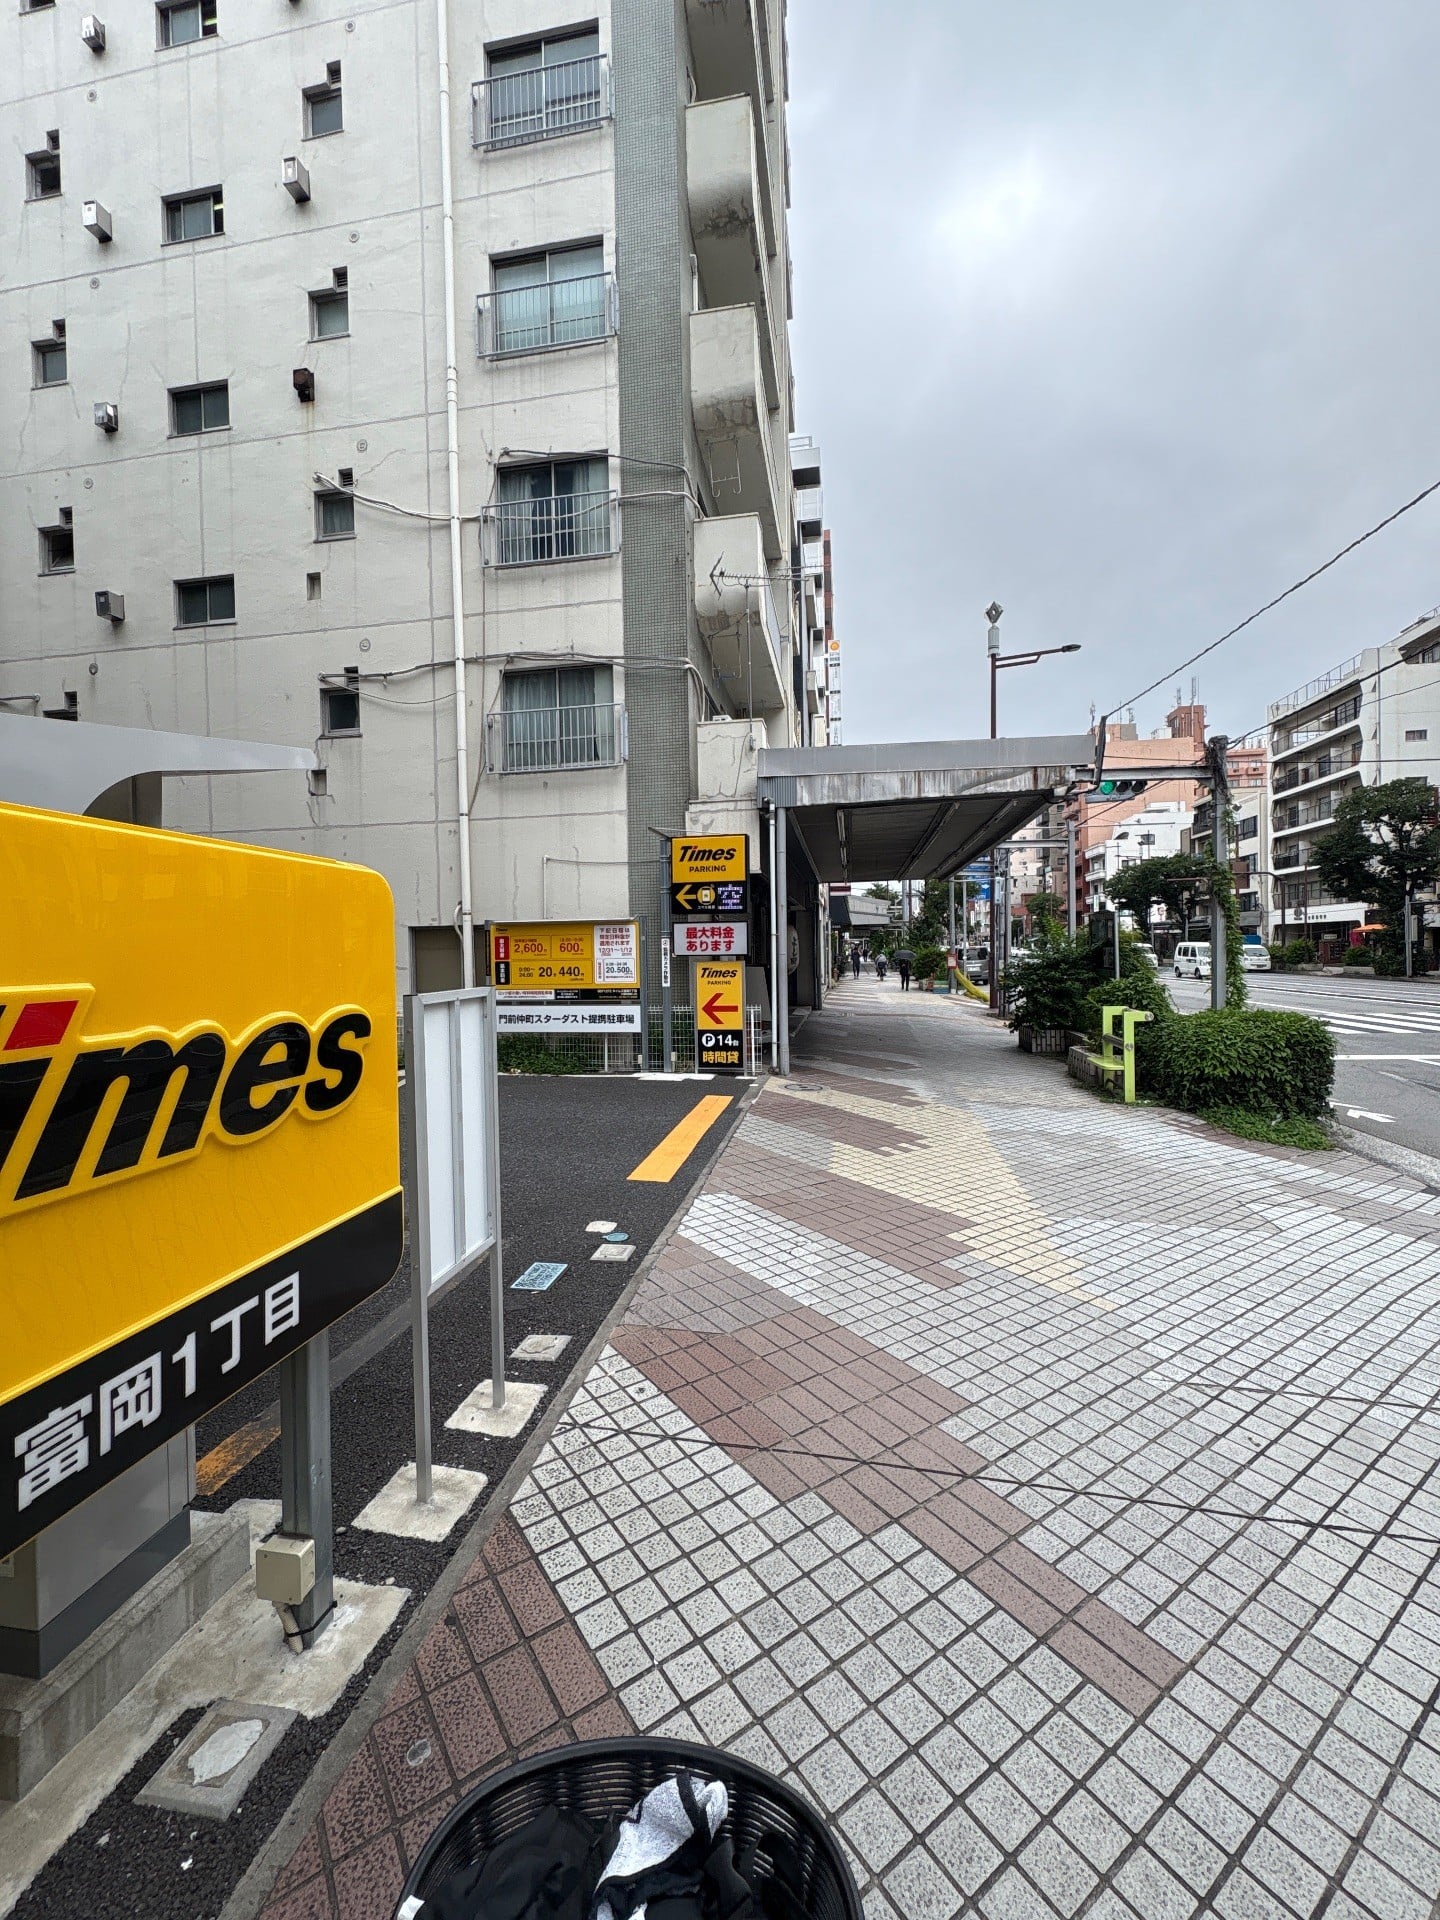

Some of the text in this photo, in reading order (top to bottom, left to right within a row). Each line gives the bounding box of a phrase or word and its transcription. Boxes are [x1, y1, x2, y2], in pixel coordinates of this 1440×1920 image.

[679, 846, 737, 862] Times
[689, 865, 726, 873] PARKING
[686, 926, 734, 939] 最大料金
[686, 940, 734, 952] あります
[701, 967, 738, 979] Times
[702, 1050, 740, 1064] 時間貸
[14, 1271, 300, 1513] 富岡1丁目
